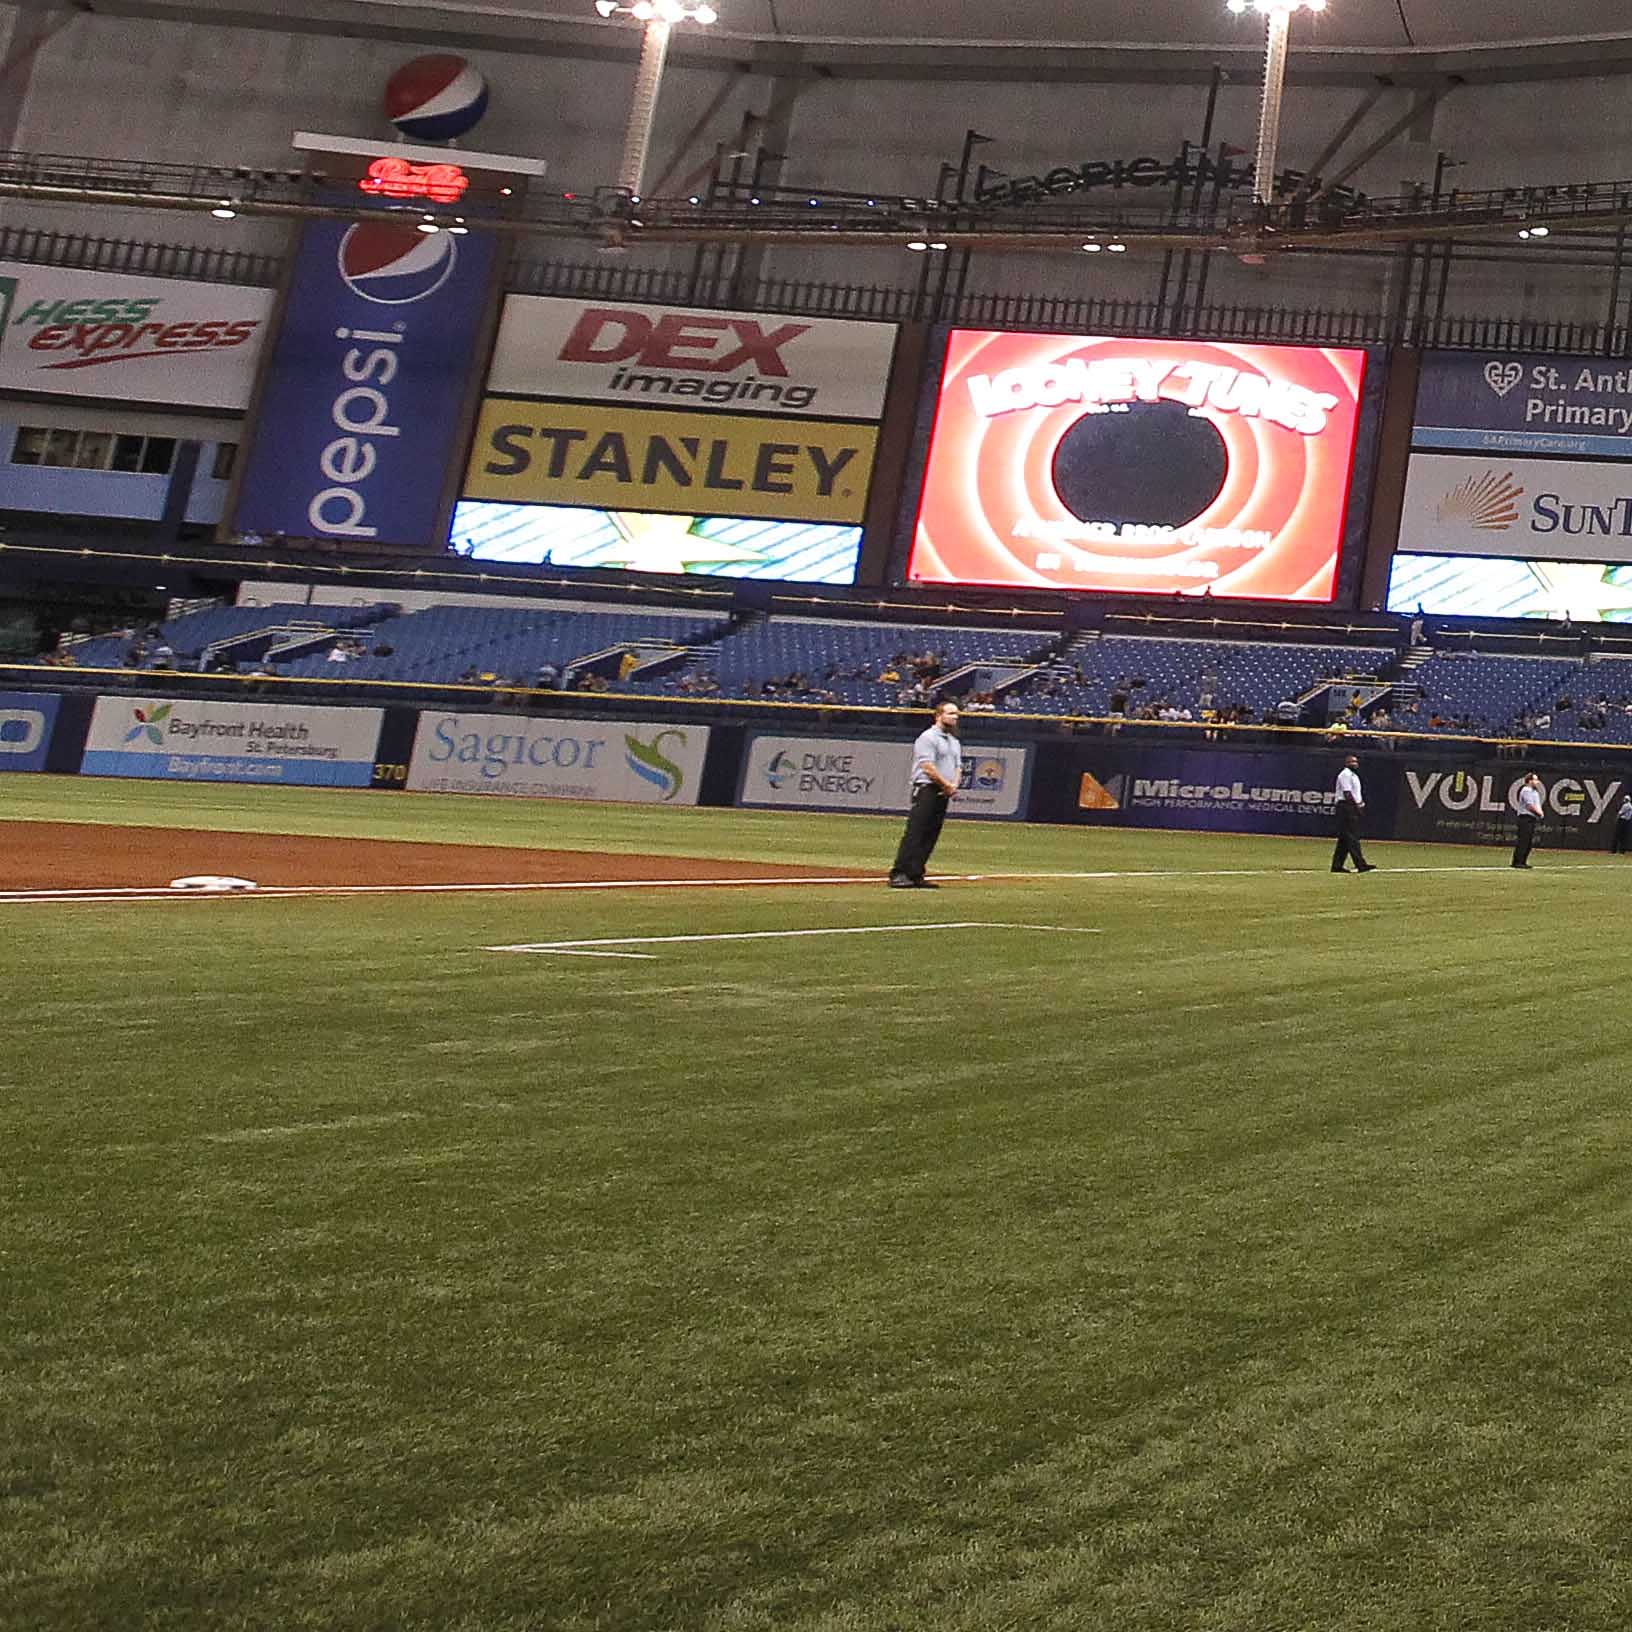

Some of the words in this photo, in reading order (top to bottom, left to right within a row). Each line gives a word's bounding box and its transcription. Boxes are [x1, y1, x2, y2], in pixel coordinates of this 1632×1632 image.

[11, 297, 164, 326] HESS
[557, 307, 812, 377] DEX
[607, 367, 818, 408] imaging
[1530, 366, 1568, 392] St.
[308, 325, 405, 538] pepsi
[484, 423, 859, 498] STANLEY
[167, 717, 246, 740] Bayfront
[247, 720, 310, 741] Health
[428, 718, 606, 779] Sagicor
[373, 763, 405, 781] 370
[801, 753, 854, 774] DUKE
[799, 773, 876, 795] ENERGY
[1163, 798, 1246, 812] PERFORMANCE
[1247, 801, 1296, 814] MEDICAL
